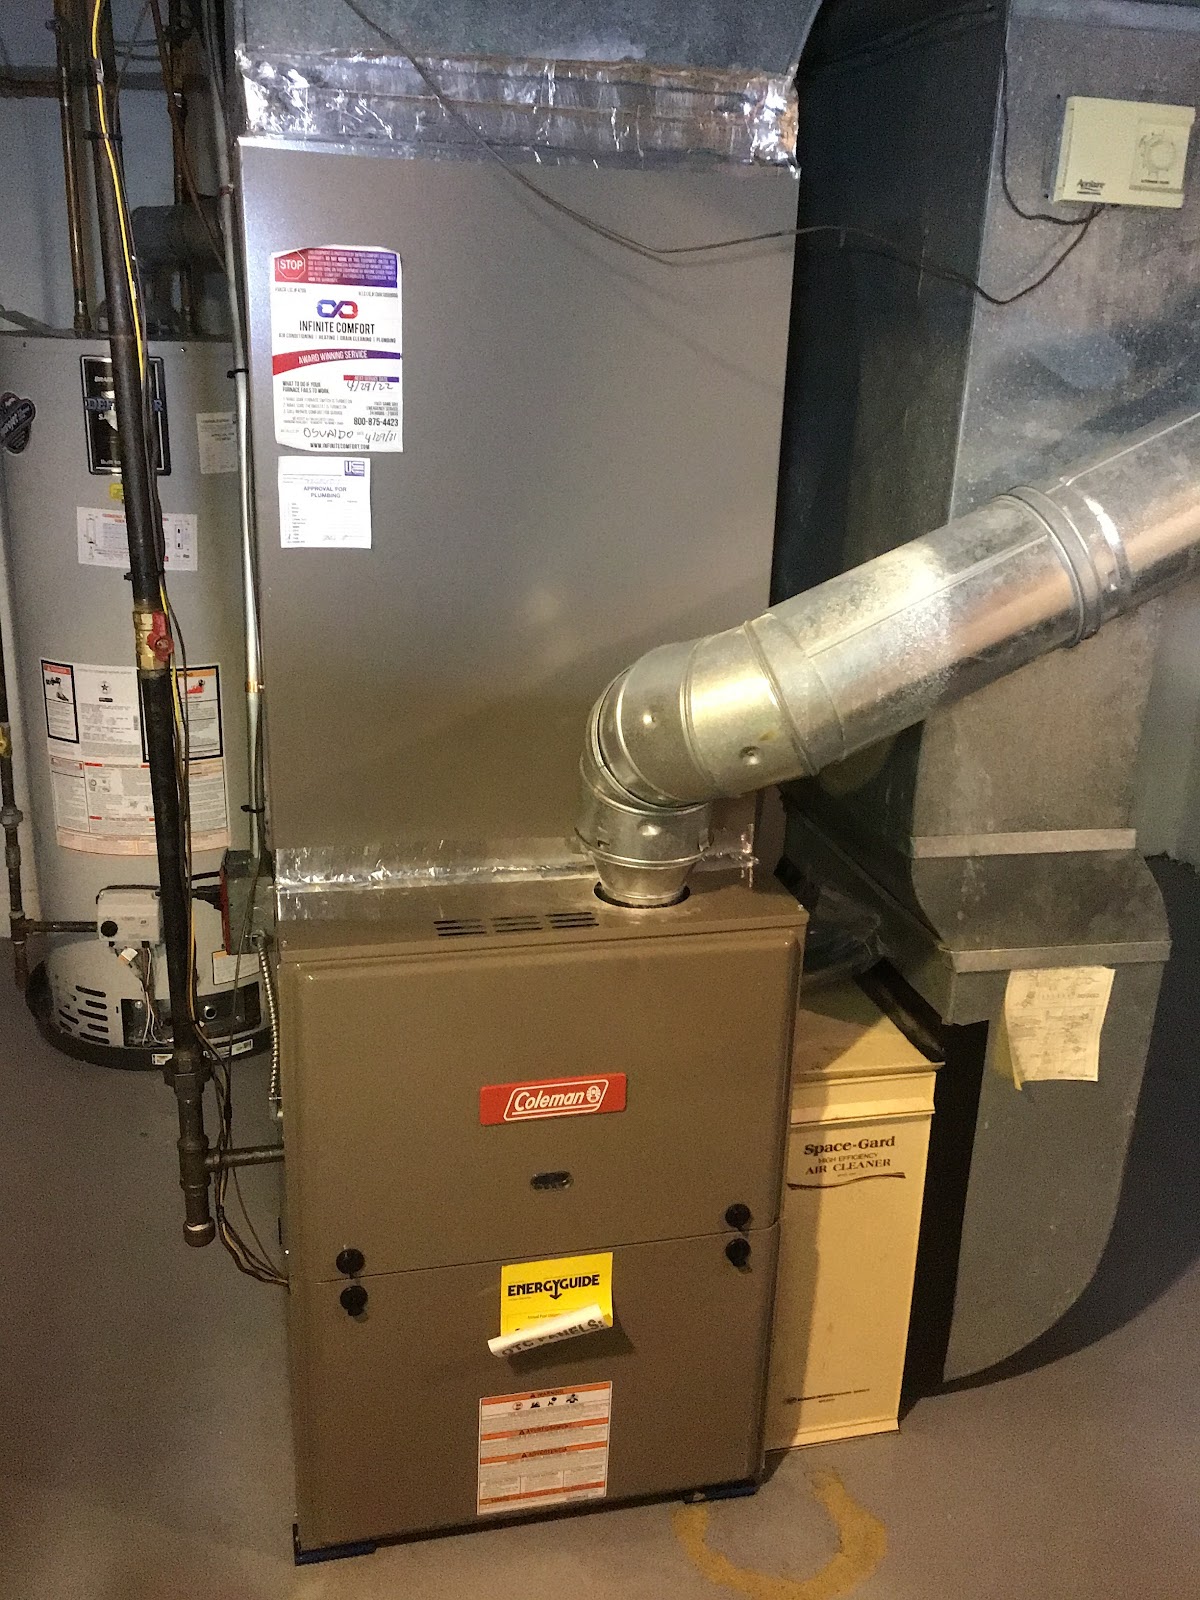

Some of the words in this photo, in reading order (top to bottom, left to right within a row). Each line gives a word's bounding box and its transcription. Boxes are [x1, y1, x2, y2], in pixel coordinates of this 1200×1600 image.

[280, 259, 303, 270] STOP
[299, 320, 334, 333] INFINITE
[336, 322, 375, 335] COMFORT
[298, 353, 320, 365] AWARD
[319, 350, 345, 361] WINNING
[345, 349, 368, 359] SERVICE
[353, 417, 399, 427] 800-875-4423
[310, 442, 370, 450] WWW.INFINITECOMFORT.COM
[514, 1090, 585, 1111] Coleman
[803, 1136, 896, 1156] Space-Gard
[838, 1152, 878, 1162] EFFICIENCY
[805, 1165, 827, 1175] AIR
[832, 1158, 891, 1172] CLEANER
[508, 1274, 600, 1298] ENERGYGUIDE
